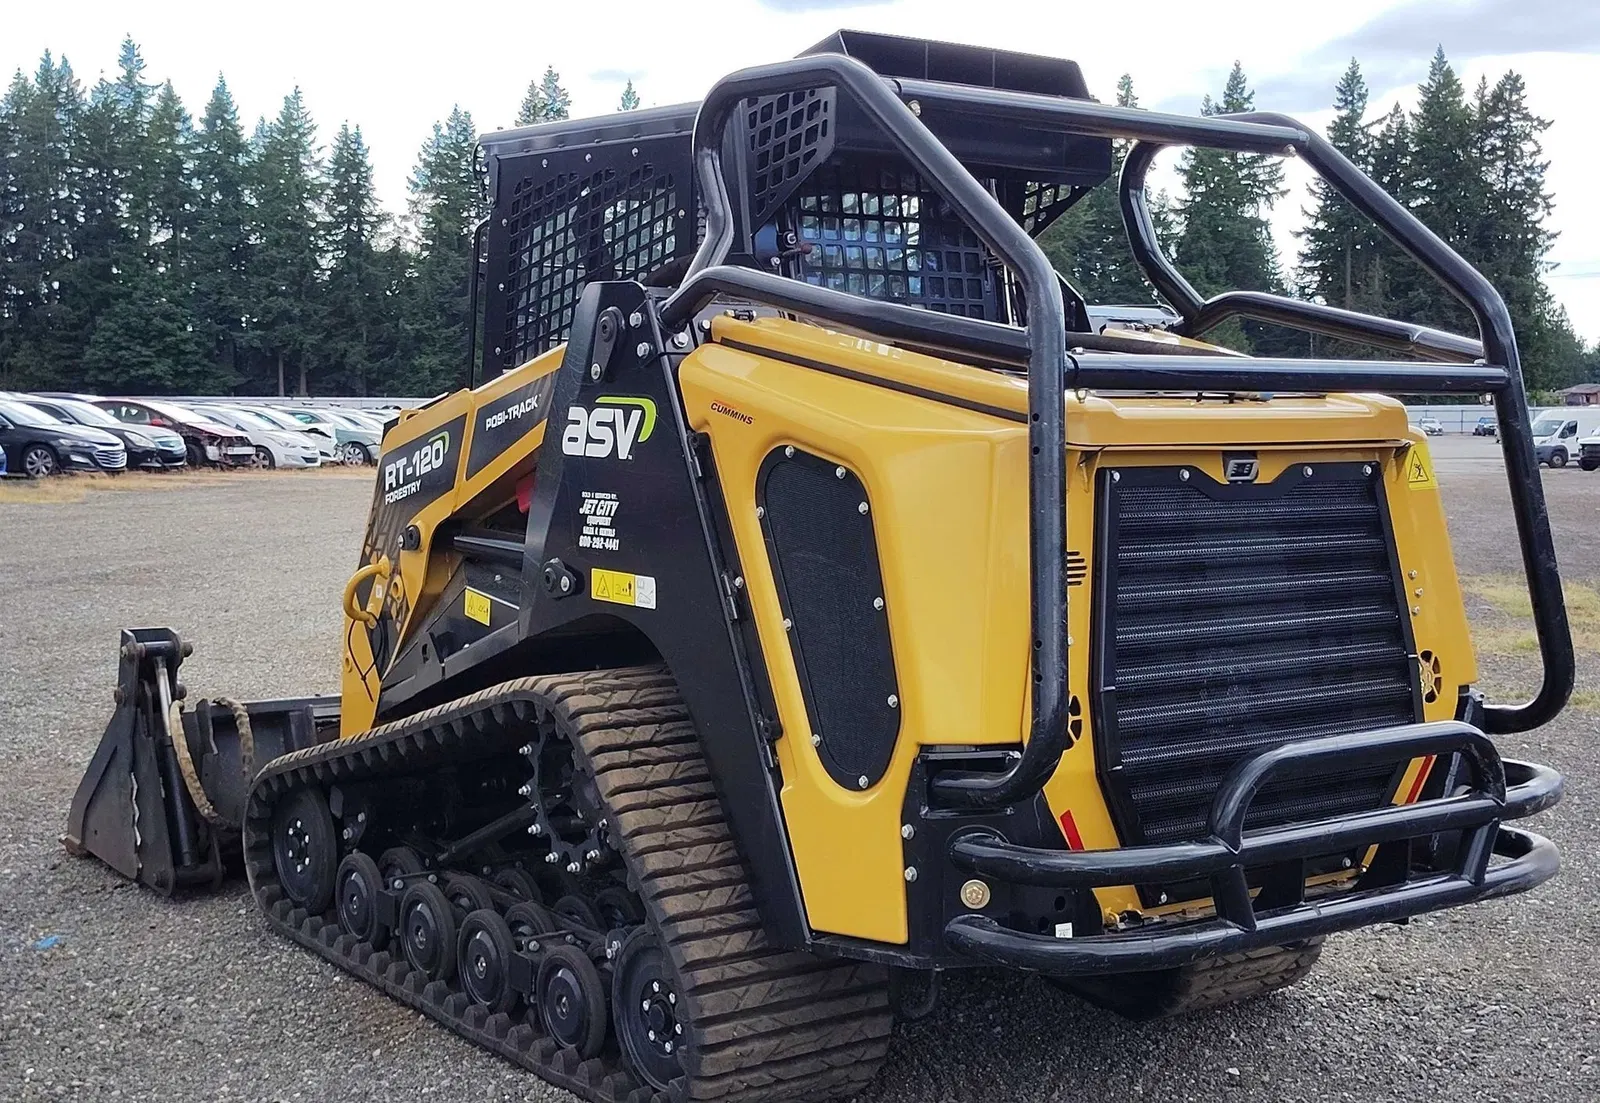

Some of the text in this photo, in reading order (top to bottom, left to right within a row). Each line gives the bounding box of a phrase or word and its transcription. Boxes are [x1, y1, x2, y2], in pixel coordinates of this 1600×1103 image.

[485, 396, 539, 431] POSI-TRACK
[710, 402, 754, 425] CUMMINS
[385, 440, 444, 491] RT-120
[385, 479, 422, 505] FORESTRY
[579, 499, 620, 516] JET CITY
